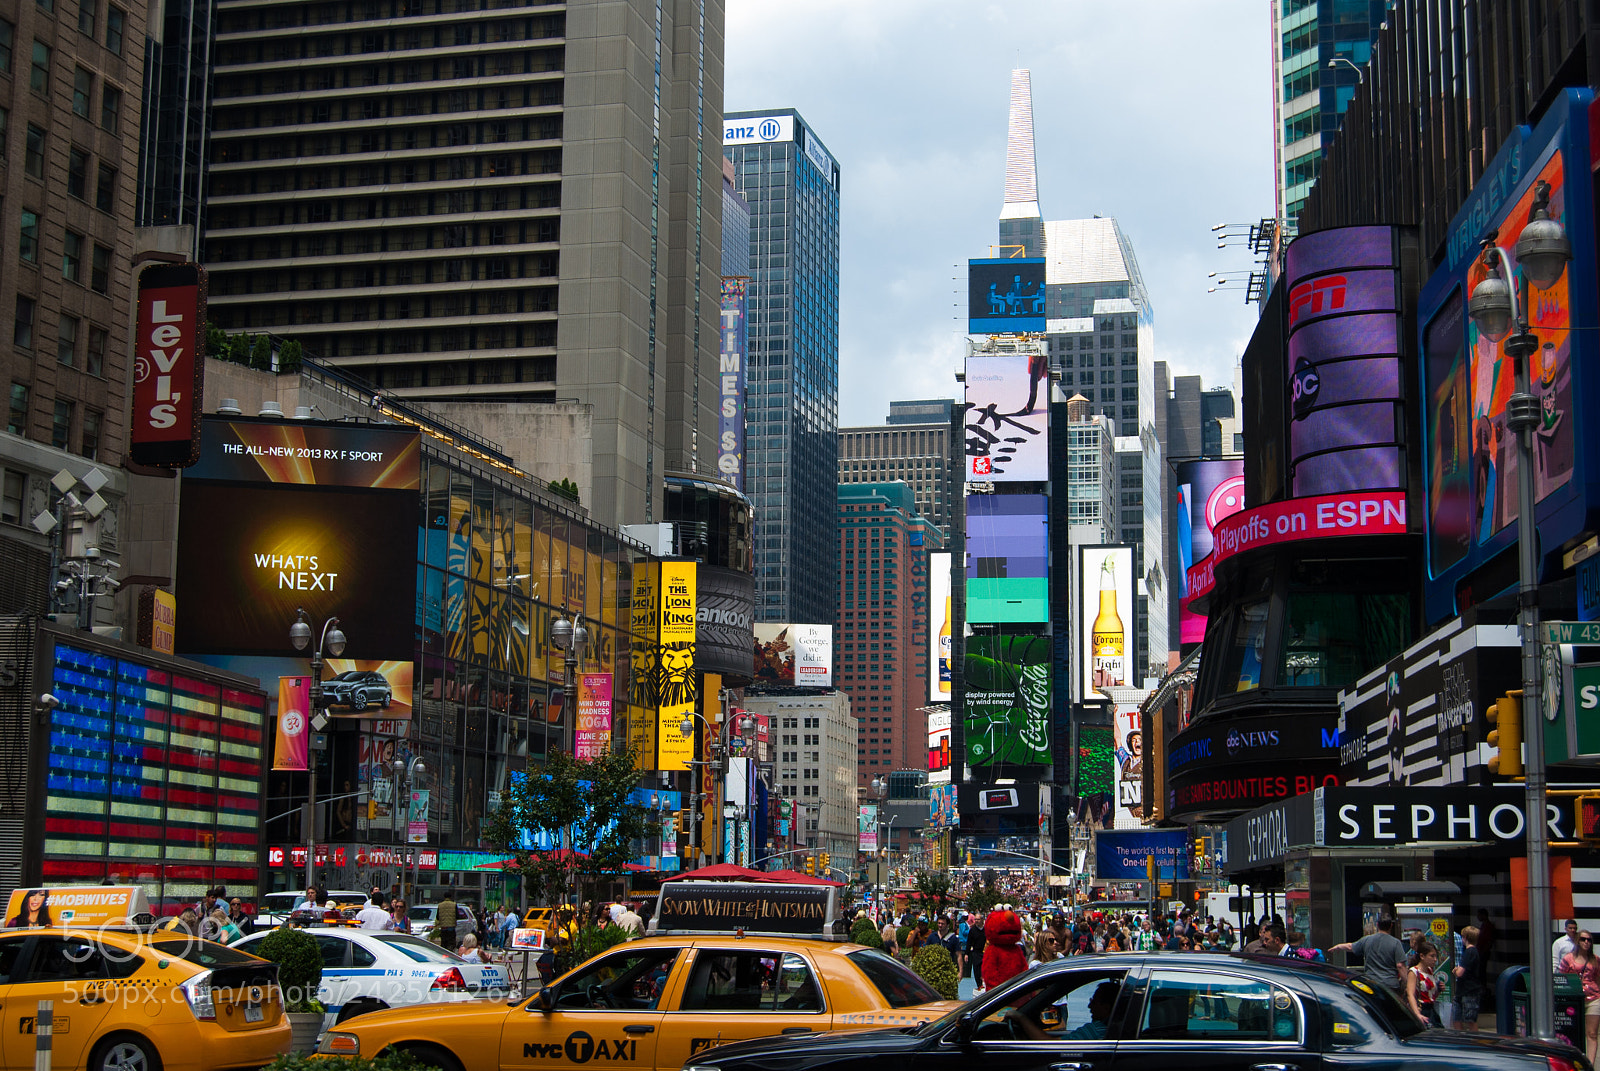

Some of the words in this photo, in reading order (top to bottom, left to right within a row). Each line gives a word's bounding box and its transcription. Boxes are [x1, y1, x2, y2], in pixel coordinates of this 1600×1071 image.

[1447, 144, 1520, 272] WRIGLEY'S
[149, 300, 184, 429] Levi's
[719, 309, 740, 418] TIMES
[223, 444, 243, 454] THE
[246, 445, 294, 457] ALL-NEW
[297, 448, 322, 459] 2013
[324, 450, 338, 460] RX
[341, 450, 347, 460] F
[349, 451, 384, 462] SPORT
[1220, 513, 1270, 552] Playoffs
[1276, 511, 1306, 534] on
[1316, 498, 1406, 529] ESPN
[254, 553, 318, 570] WHAT'S
[279, 571, 338, 592] NEXT
[668, 586, 688, 594] THE
[666, 596, 690, 609] LION
[154, 598, 175, 627] BUBBA
[664, 611, 694, 626] KING
[155, 626, 172, 651] GUMP
[810, 628, 819, 638] By
[1094, 635, 1122, 646] Corona
[1560, 625, 1572, 641] W
[1580, 625, 1600, 641] 43
[803, 654, 815, 662] did
[1580, 685, 1600, 709] S
[579, 716, 609, 728] YOGA
[1198, 738, 1212, 758] NYC
[1240, 730, 1280, 748] NEWS
[1191, 782, 1211, 804] SAINTS
[1214, 776, 1288, 800] BOUNTIES
[1338, 804, 1564, 839] SEPHOR
[1247, 806, 1288, 862] SEPHORA
[1116, 846, 1129, 854] The
[1131, 846, 1154, 854] world's
[46, 893, 128, 906] #MOBWIVES
[663, 897, 702, 916] SNOW
[703, 898, 746, 917] WHITE
[754, 900, 826, 919] HUNTSMAN
[86, 981, 109, 990] 7V27
[481, 978, 504, 986] POLICE
[840, 1015, 874, 1024] 1K13
[524, 1043, 562, 1058] NYC
[566, 1034, 636, 1061] TAXI
